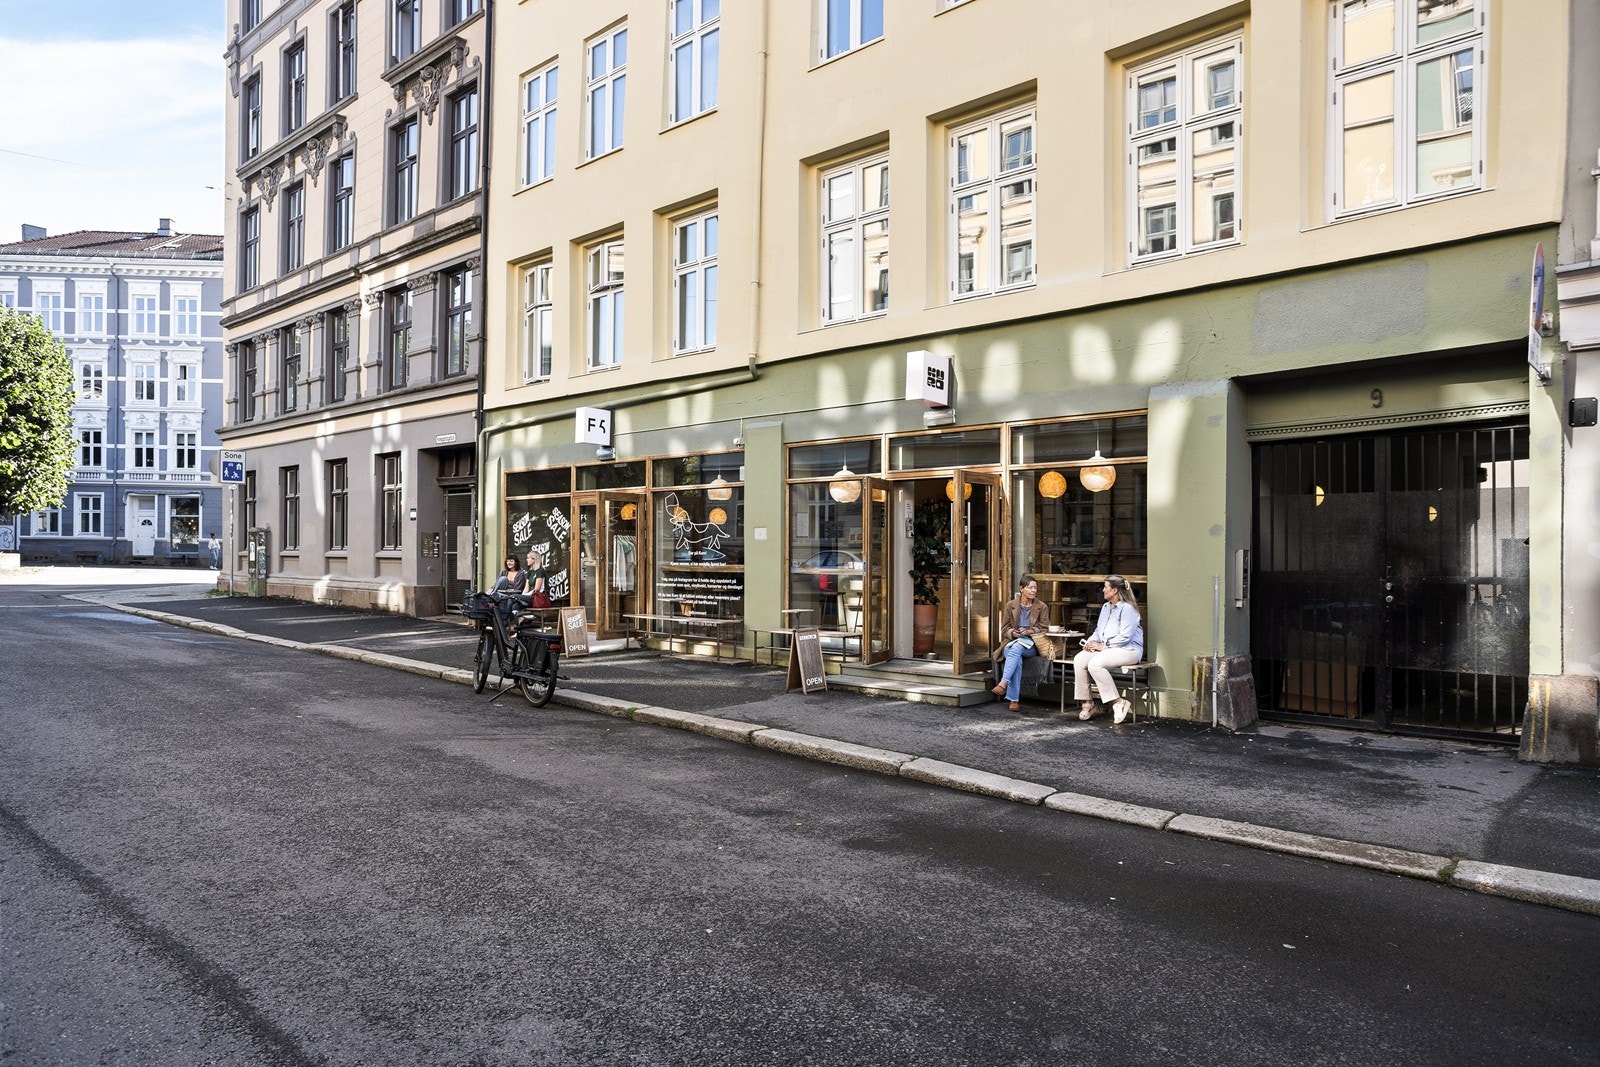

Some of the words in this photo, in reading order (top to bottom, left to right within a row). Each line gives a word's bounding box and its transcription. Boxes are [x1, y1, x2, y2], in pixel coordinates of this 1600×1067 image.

[1370, 388, 1383, 408] 9
[587, 417, 606, 434] F5
[224, 451, 242, 460] Sone
[513, 521, 533, 547] SALE
[546, 514, 567, 543] SALE
[549, 578, 570, 602] SALE
[568, 617, 584, 630] SALE
[568, 644, 586, 652] OPEN
[806, 676, 823, 686] OPEN
